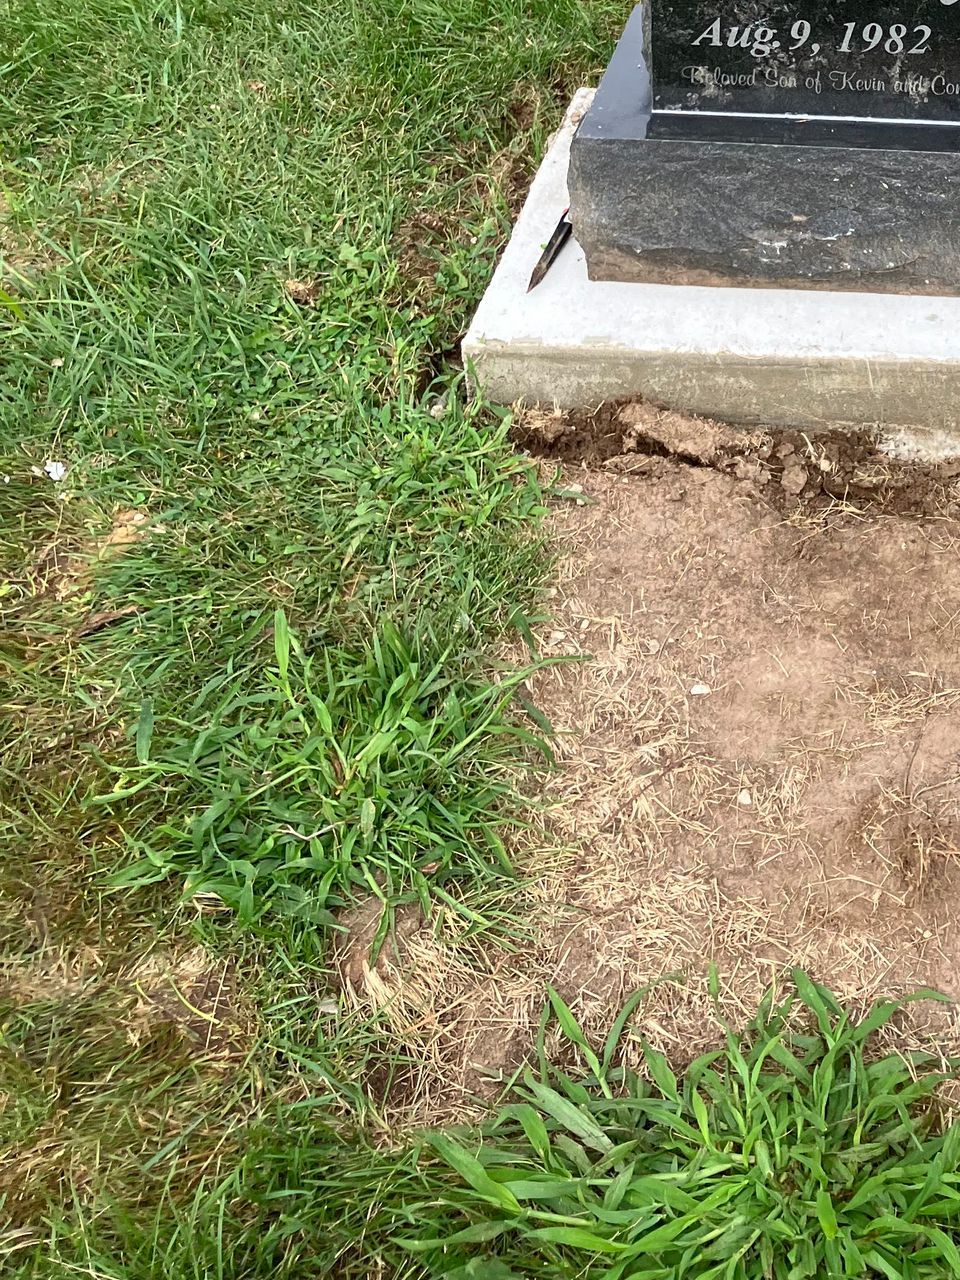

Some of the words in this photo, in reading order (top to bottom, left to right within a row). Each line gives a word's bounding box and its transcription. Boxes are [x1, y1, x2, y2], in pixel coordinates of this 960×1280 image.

[836, 21, 932, 54] 1982
[681, 65, 756, 87] Beloved
[764, 69, 797, 88] Son
[805, 71, 823, 95] of
[828, 70, 886, 92] Kevin
[893, 73, 924, 95] and
